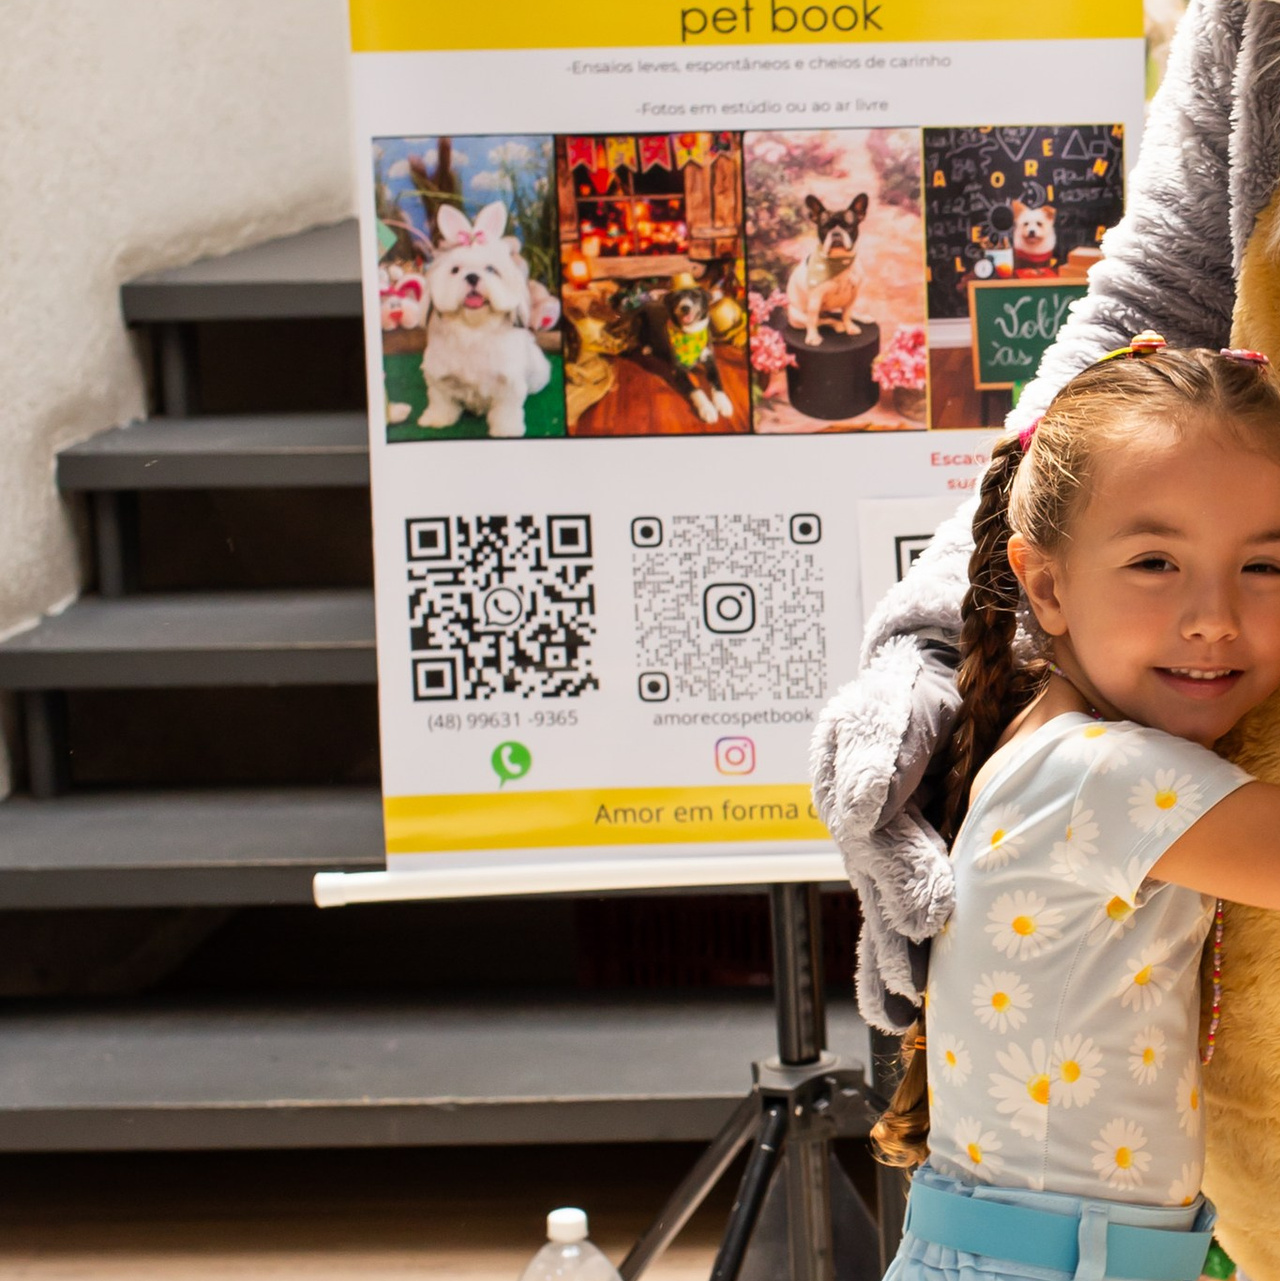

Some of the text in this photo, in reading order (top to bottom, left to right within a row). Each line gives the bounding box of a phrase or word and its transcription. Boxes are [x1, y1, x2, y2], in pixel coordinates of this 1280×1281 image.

[566, 60, 633, 75] -Ensaios
[685, 57, 791, 74] espontâneos
[794, 59, 804, 70] e
[808, 56, 861, 70] cheios
[864, 55, 886, 69] de
[889, 54, 952, 69] carinho
[635, 97, 889, 116] -Fotos em estúdio ou ao ar livre
[930, 452, 991, 467] Escan
[427, 709, 579, 732] (48) 99631 -9365
[653, 707, 815, 728] amorecospetbook
[594, 803, 664, 825] Amor
[673, 805, 713, 823] em
[721, 799, 799, 821] forma
